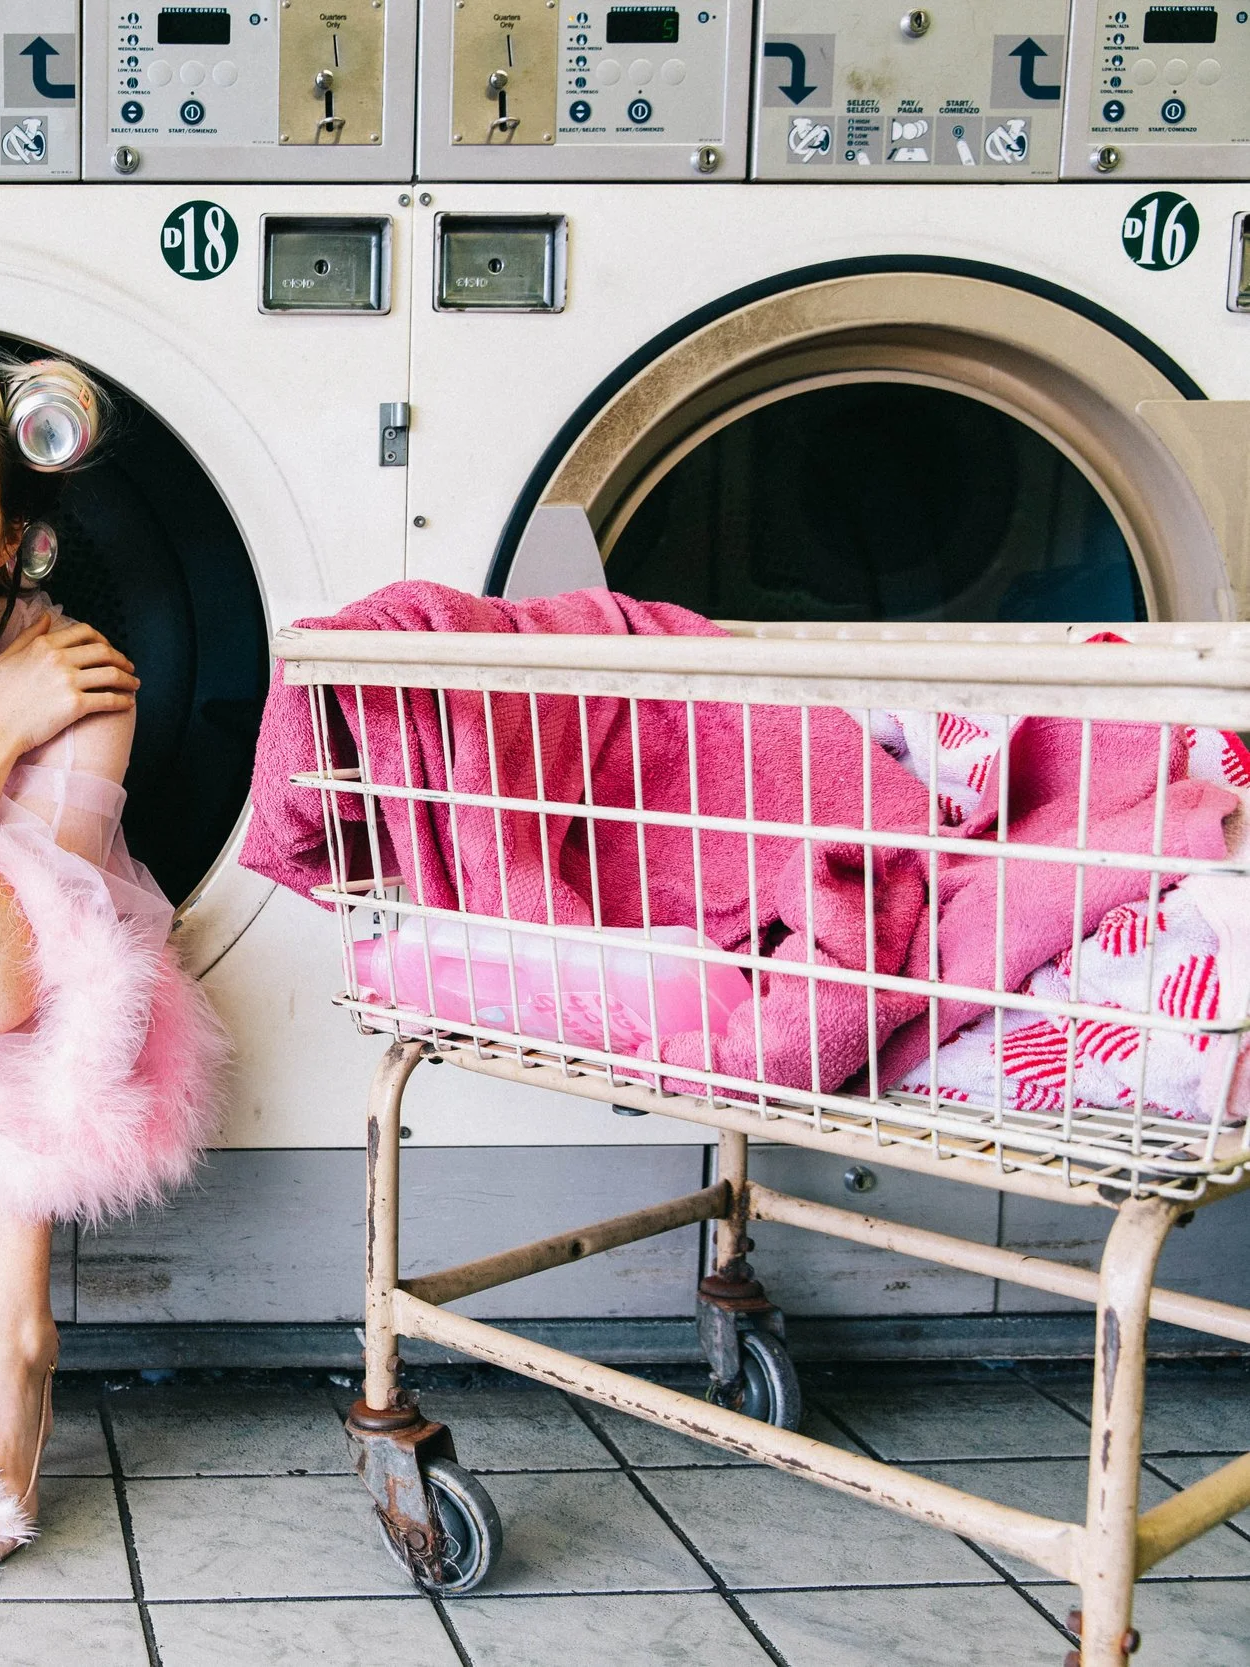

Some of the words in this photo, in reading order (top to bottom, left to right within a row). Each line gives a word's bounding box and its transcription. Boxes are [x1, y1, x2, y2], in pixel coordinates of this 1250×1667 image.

[319, 13, 347, 21] Quarters
[493, 13, 521, 21] Quarters
[326, 21, 340, 29] Only
[500, 21, 514, 29] Only
[1123, 198, 1191, 266] D16
[163, 205, 227, 273] D18
